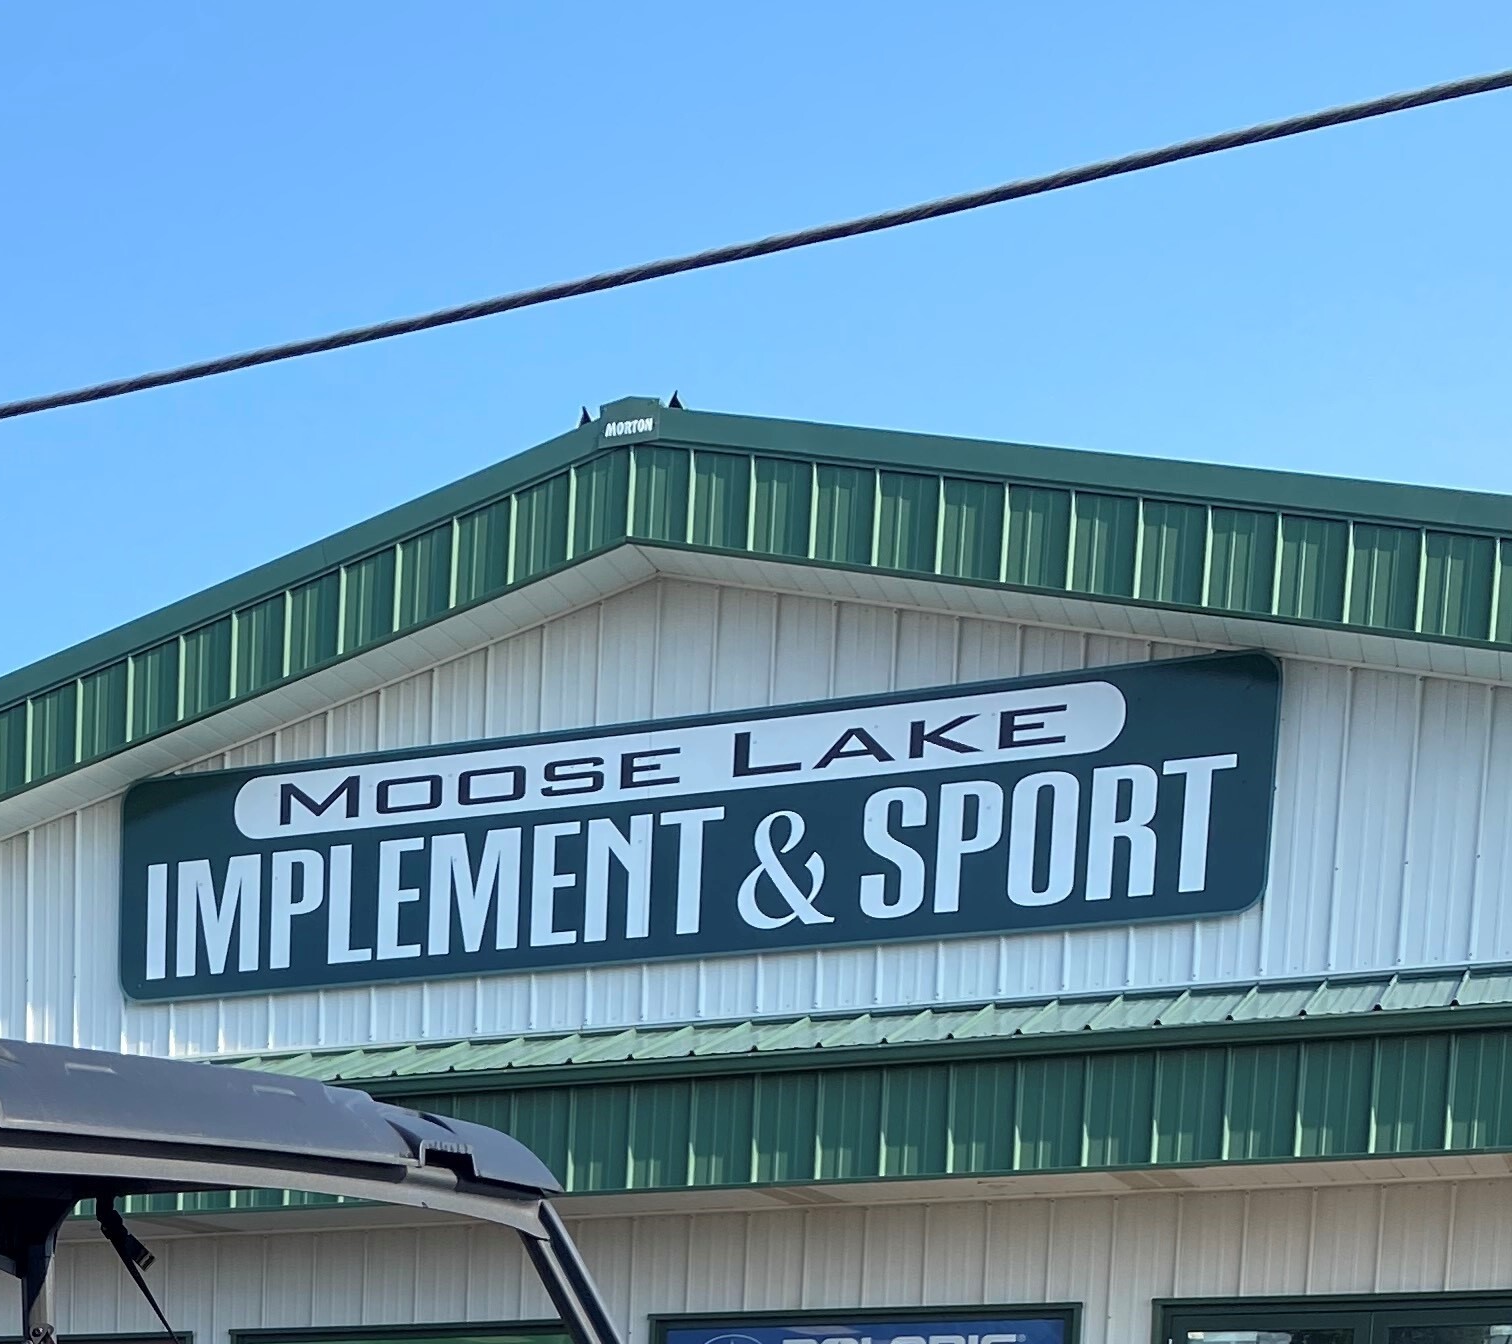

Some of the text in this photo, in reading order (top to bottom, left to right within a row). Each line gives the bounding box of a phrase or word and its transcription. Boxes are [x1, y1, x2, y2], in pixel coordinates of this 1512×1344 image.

[604, 417, 654, 438] MORTON
[279, 703, 1068, 826] MOOSE LAKE
[145, 753, 1238, 981] IMPLEMENT & SPORT
